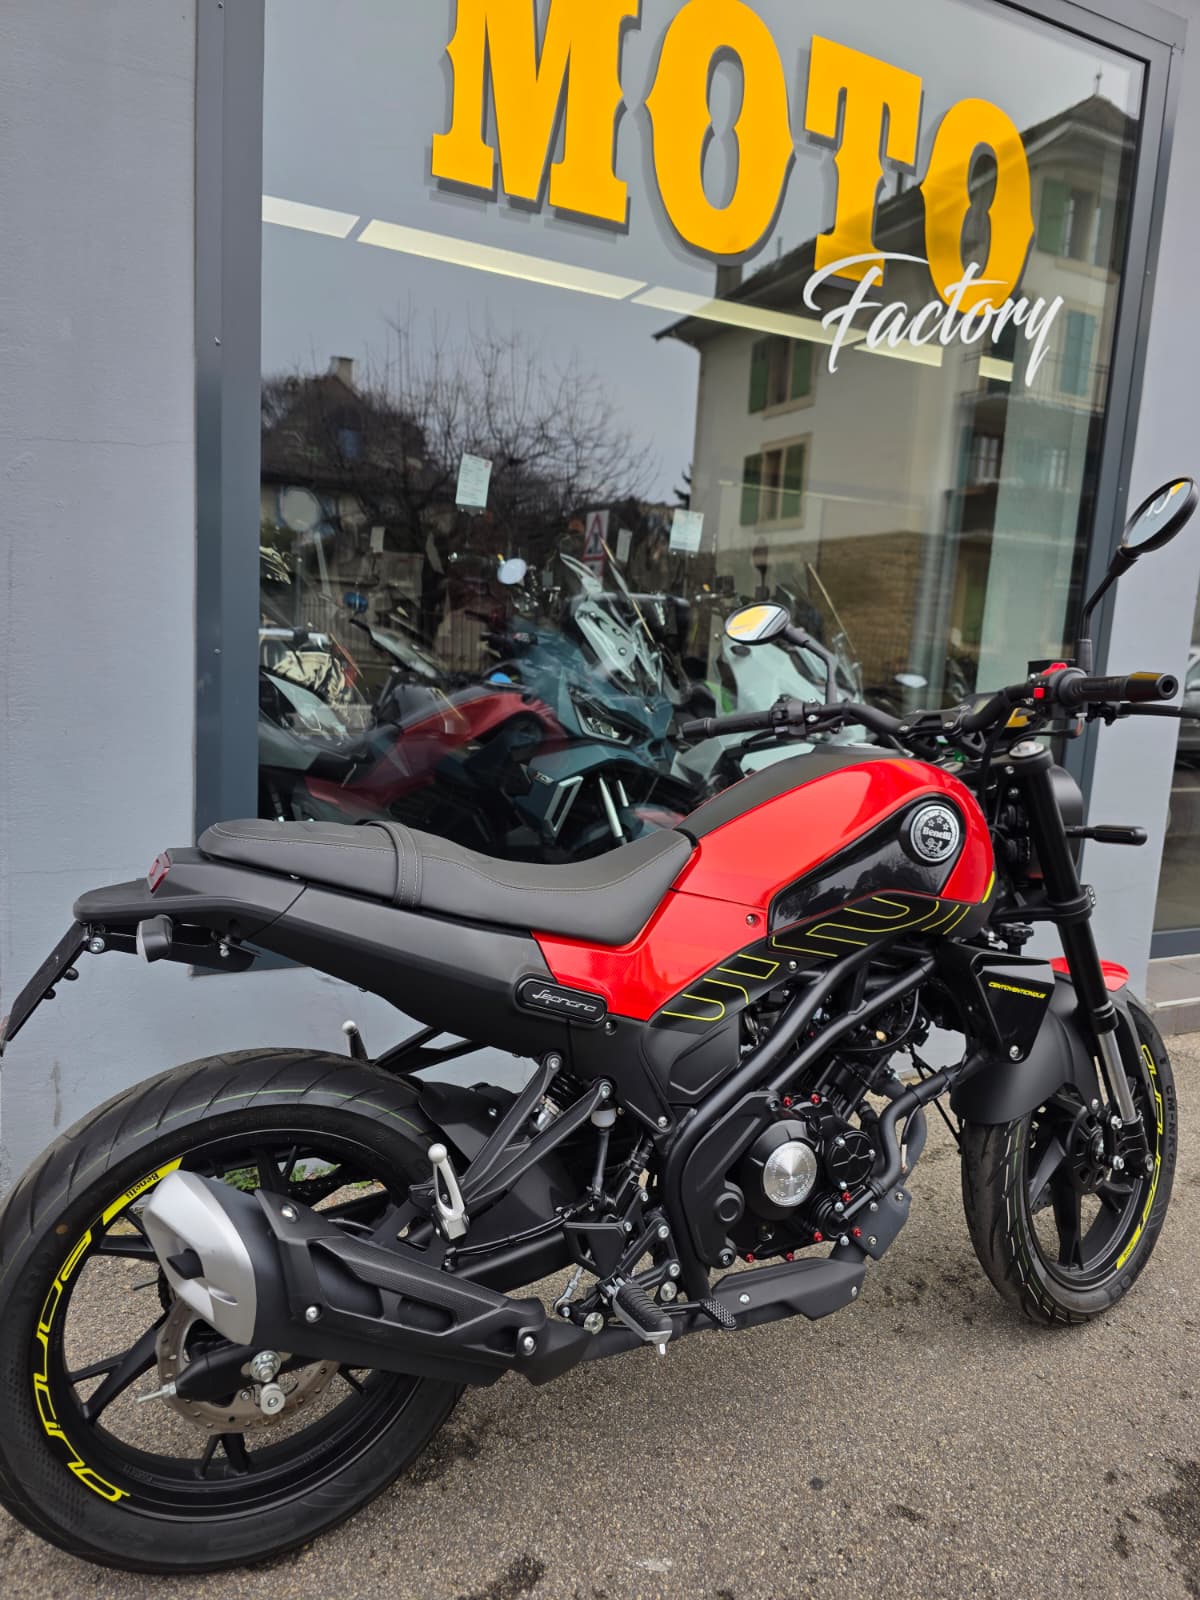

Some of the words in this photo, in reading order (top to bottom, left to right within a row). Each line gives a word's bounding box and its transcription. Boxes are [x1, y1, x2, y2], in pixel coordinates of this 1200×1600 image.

[431, 0, 1035, 316] MOTO
[802, 252, 1064, 386] Factory
[921, 825, 953, 841] Benelli
[125, 1172, 160, 1200] Benelli
